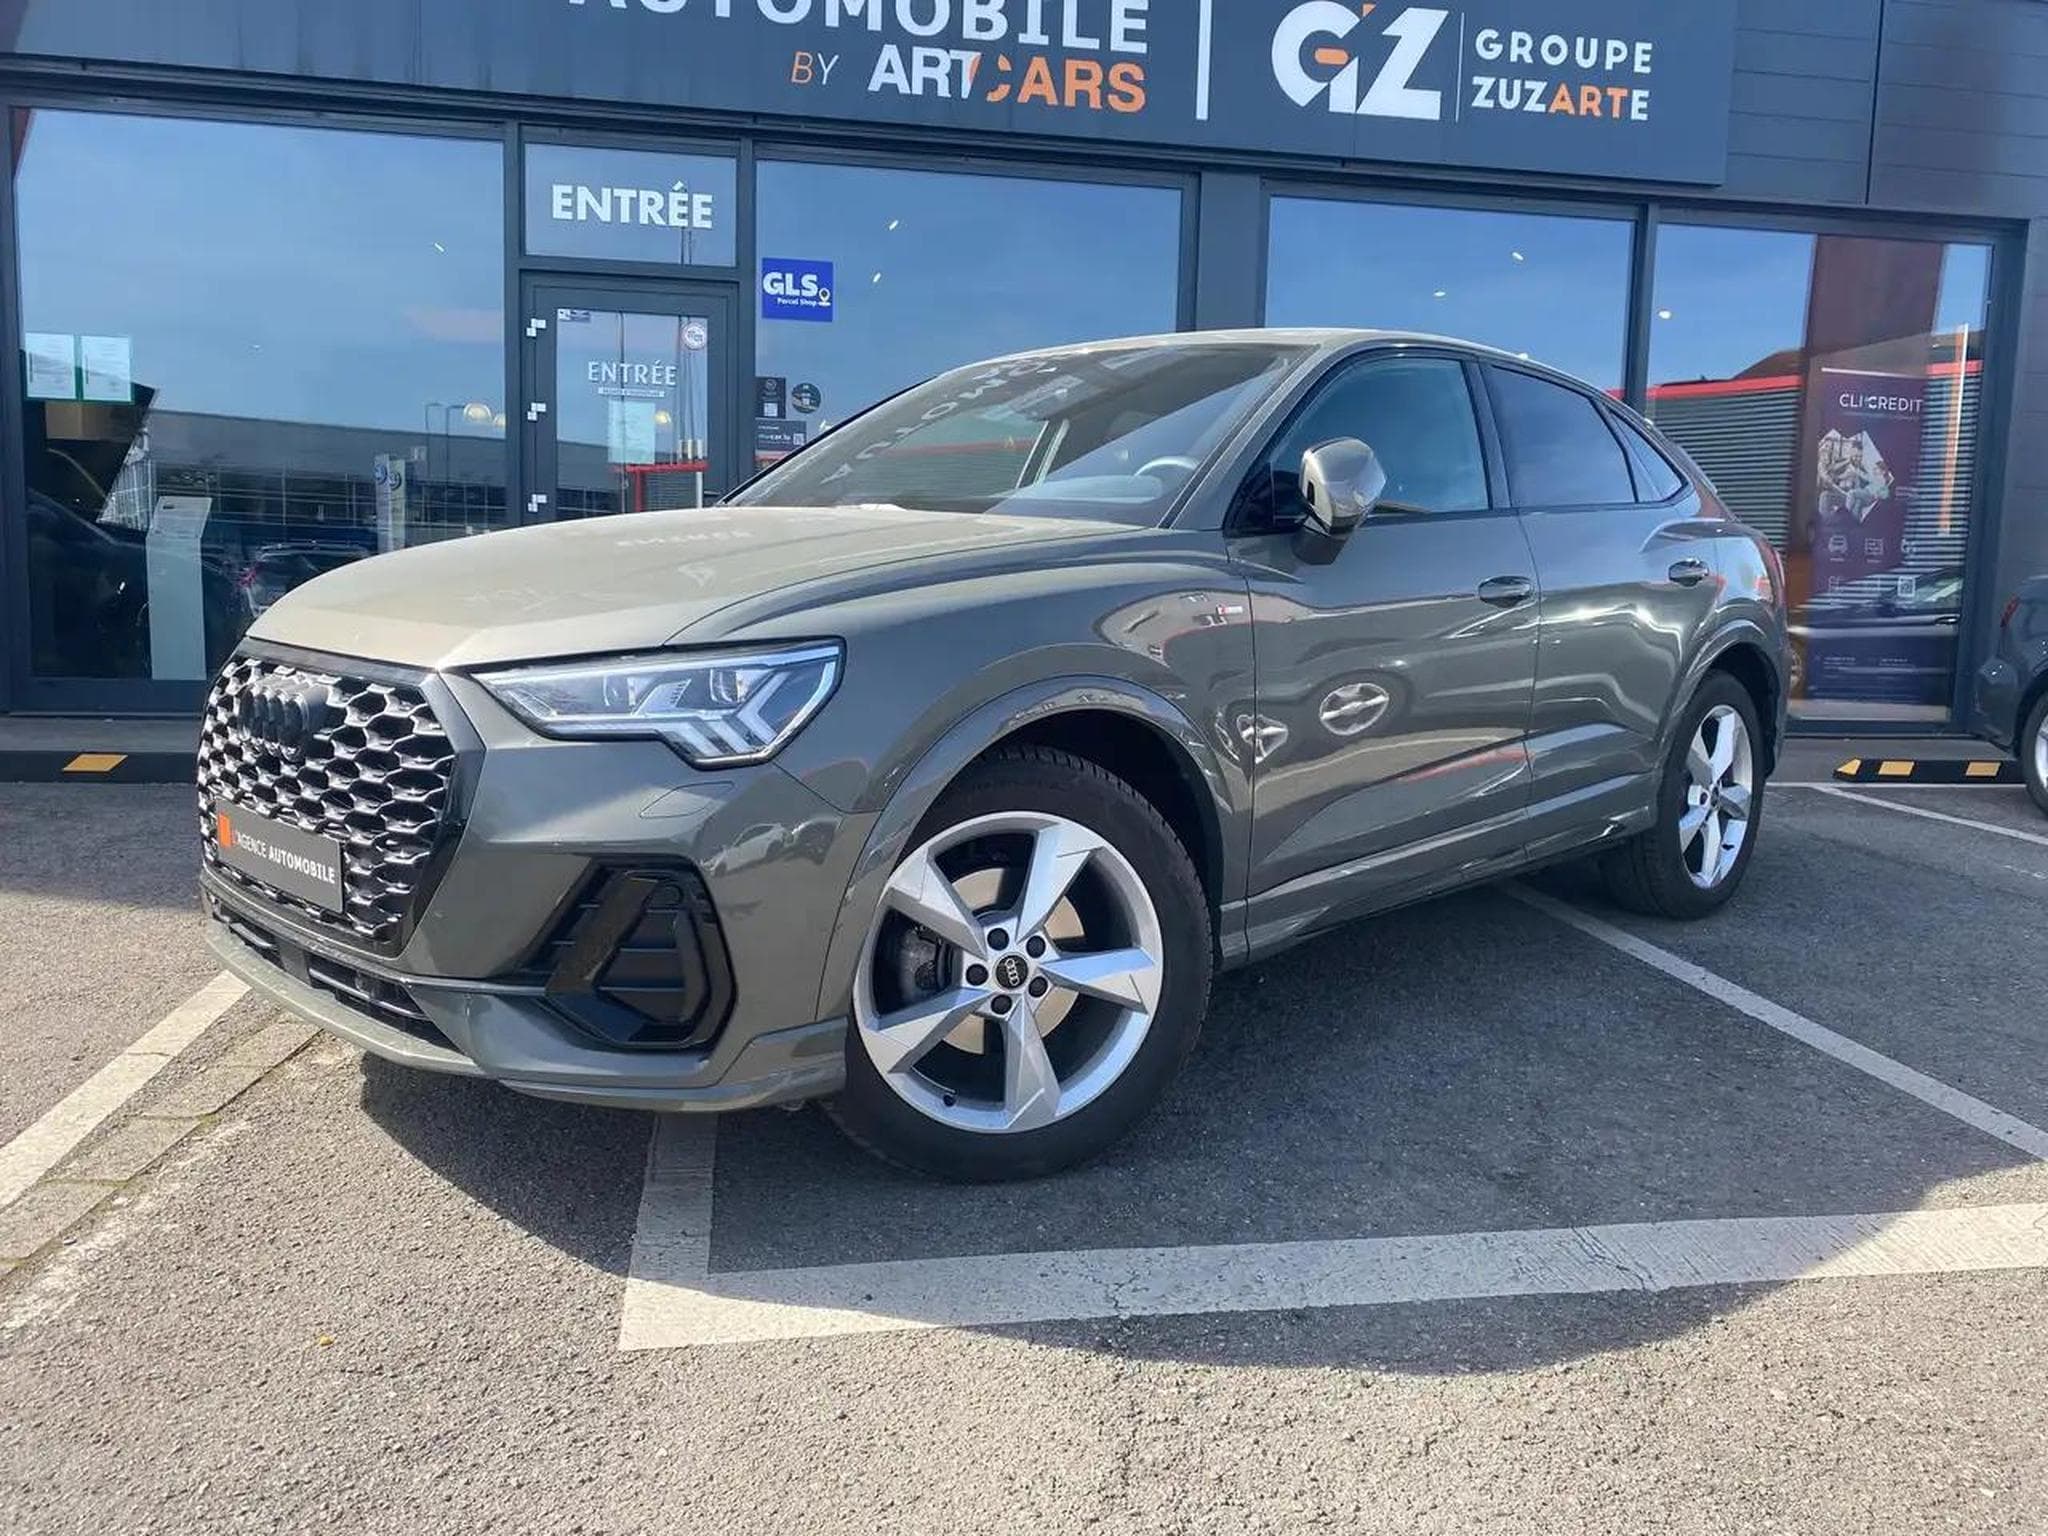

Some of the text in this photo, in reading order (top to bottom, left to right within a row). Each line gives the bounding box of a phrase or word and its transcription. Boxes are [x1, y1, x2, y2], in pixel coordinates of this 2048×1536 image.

[789, 49, 841, 87] BY
[1474, 27, 1654, 75] GROUPE
[1471, 76, 1650, 122] ZUZARTE
[551, 180, 713, 230] ENTRÉE
[587, 359, 678, 387] ENTRÉE
[268, 844, 337, 885] AUTOMOBILE
